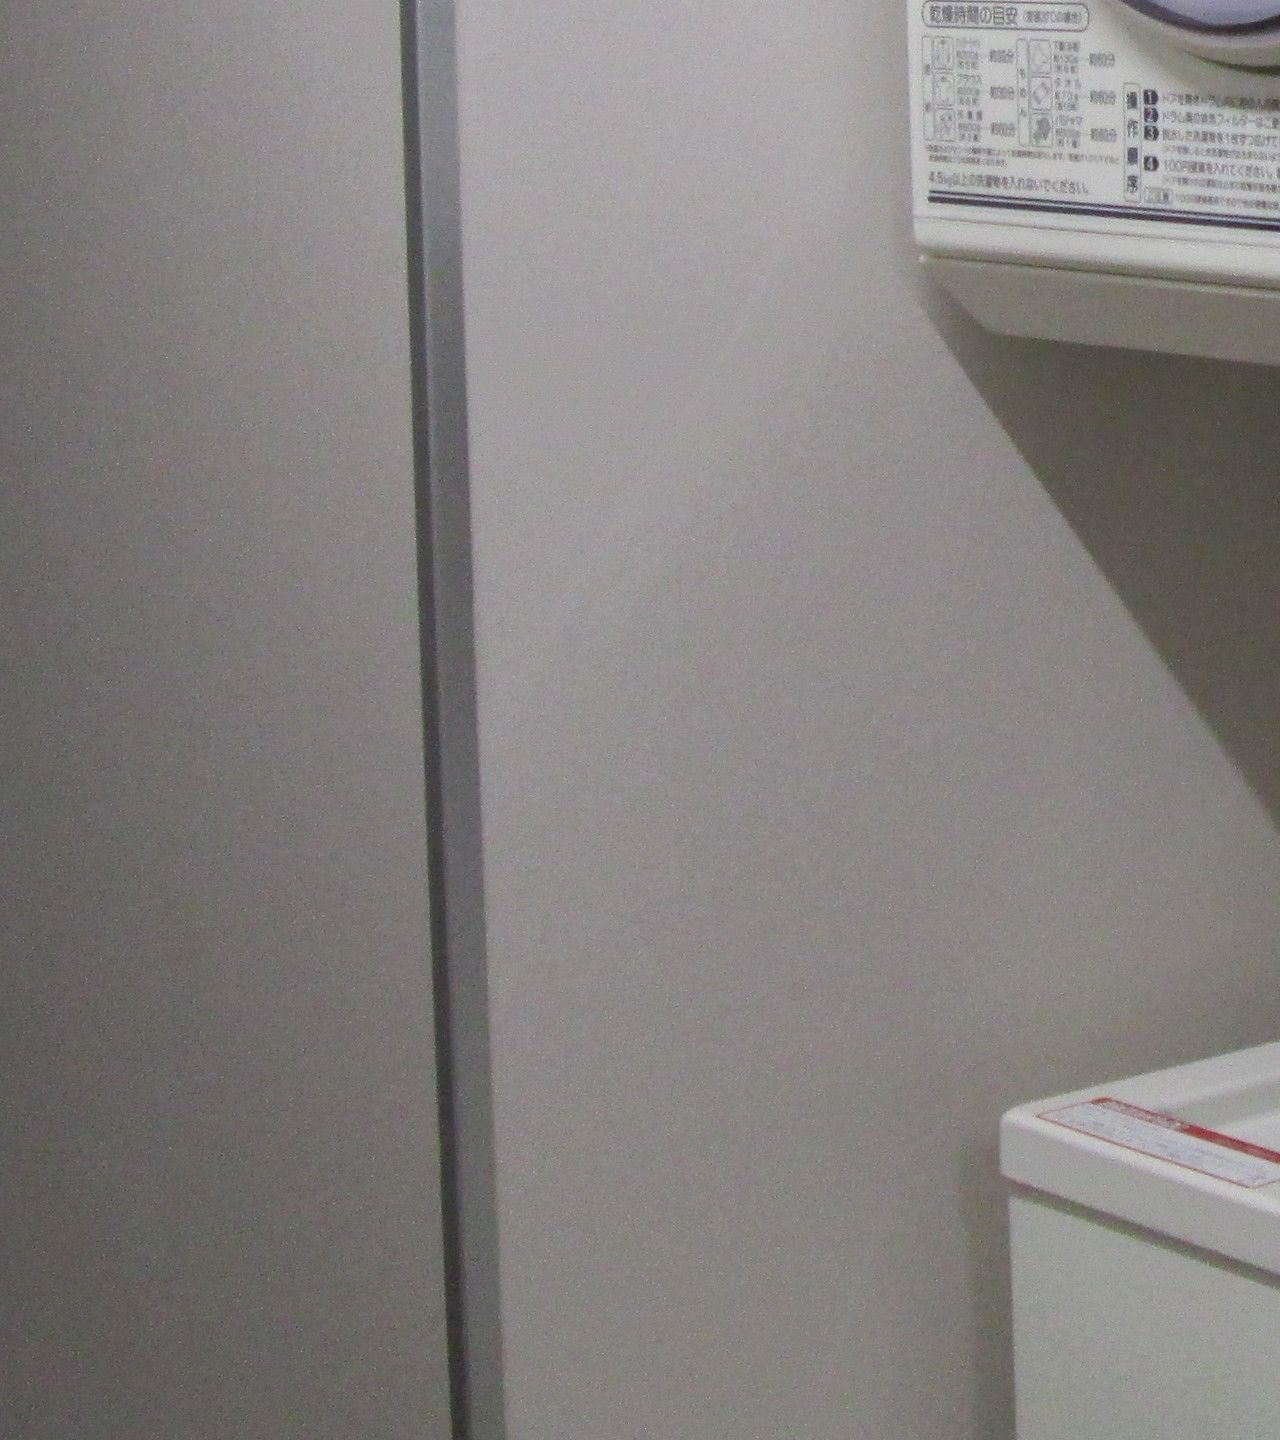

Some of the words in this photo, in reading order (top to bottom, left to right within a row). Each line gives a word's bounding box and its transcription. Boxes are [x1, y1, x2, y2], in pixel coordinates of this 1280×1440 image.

[929, 5, 1019, 26] 乾燥時間の目安
